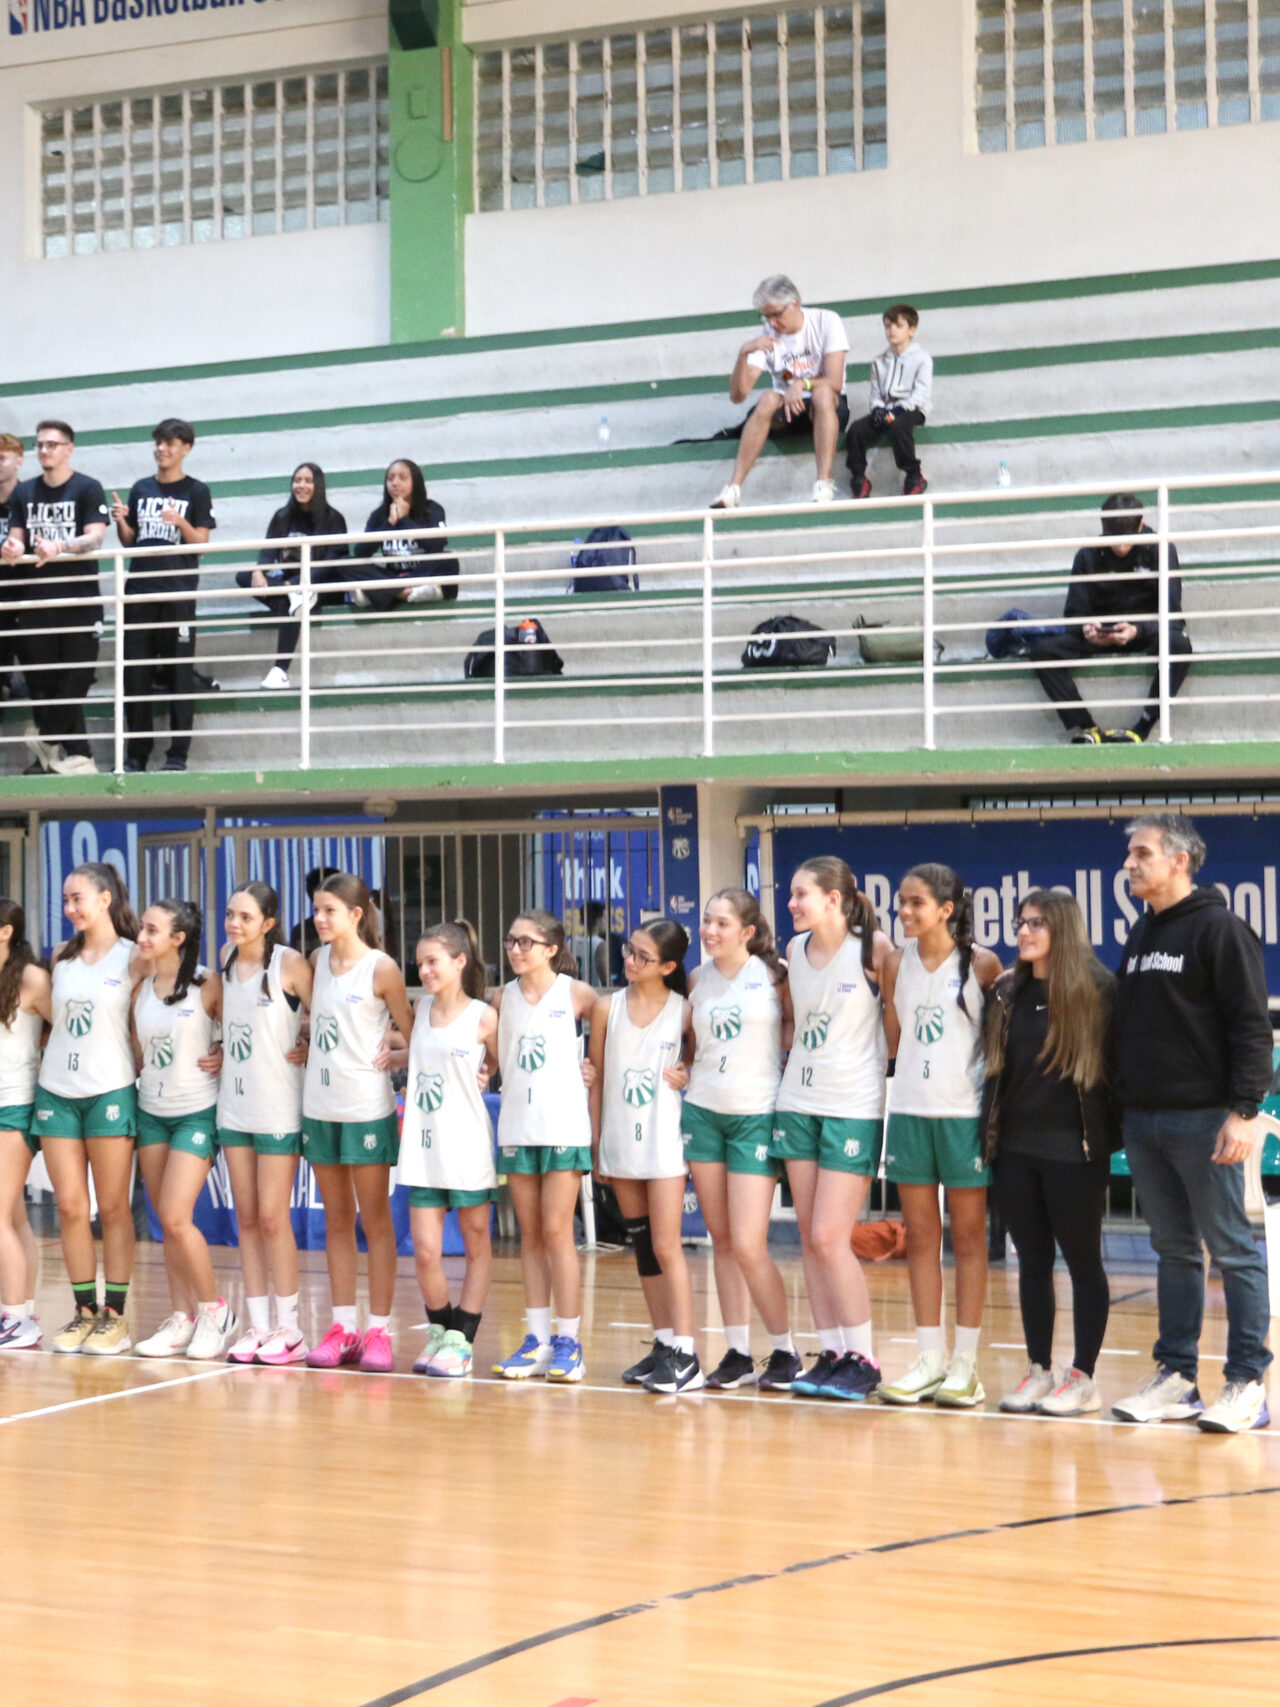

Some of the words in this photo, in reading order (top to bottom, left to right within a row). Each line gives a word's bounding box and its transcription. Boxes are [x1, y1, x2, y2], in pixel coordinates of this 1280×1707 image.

[26, 501, 76, 522] LICEU
[68, 1052, 80, 1071] 13
[719, 1056, 727, 1073] 2
[923, 1060, 930, 1079] 3
[234, 1077, 244, 1095] 14
[320, 1068, 330, 1086] 10
[801, 1066, 813, 1087] 12
[527, 1087, 532, 1104] 1
[421, 1129, 432, 1149] 15
[635, 1122, 642, 1141] 8
